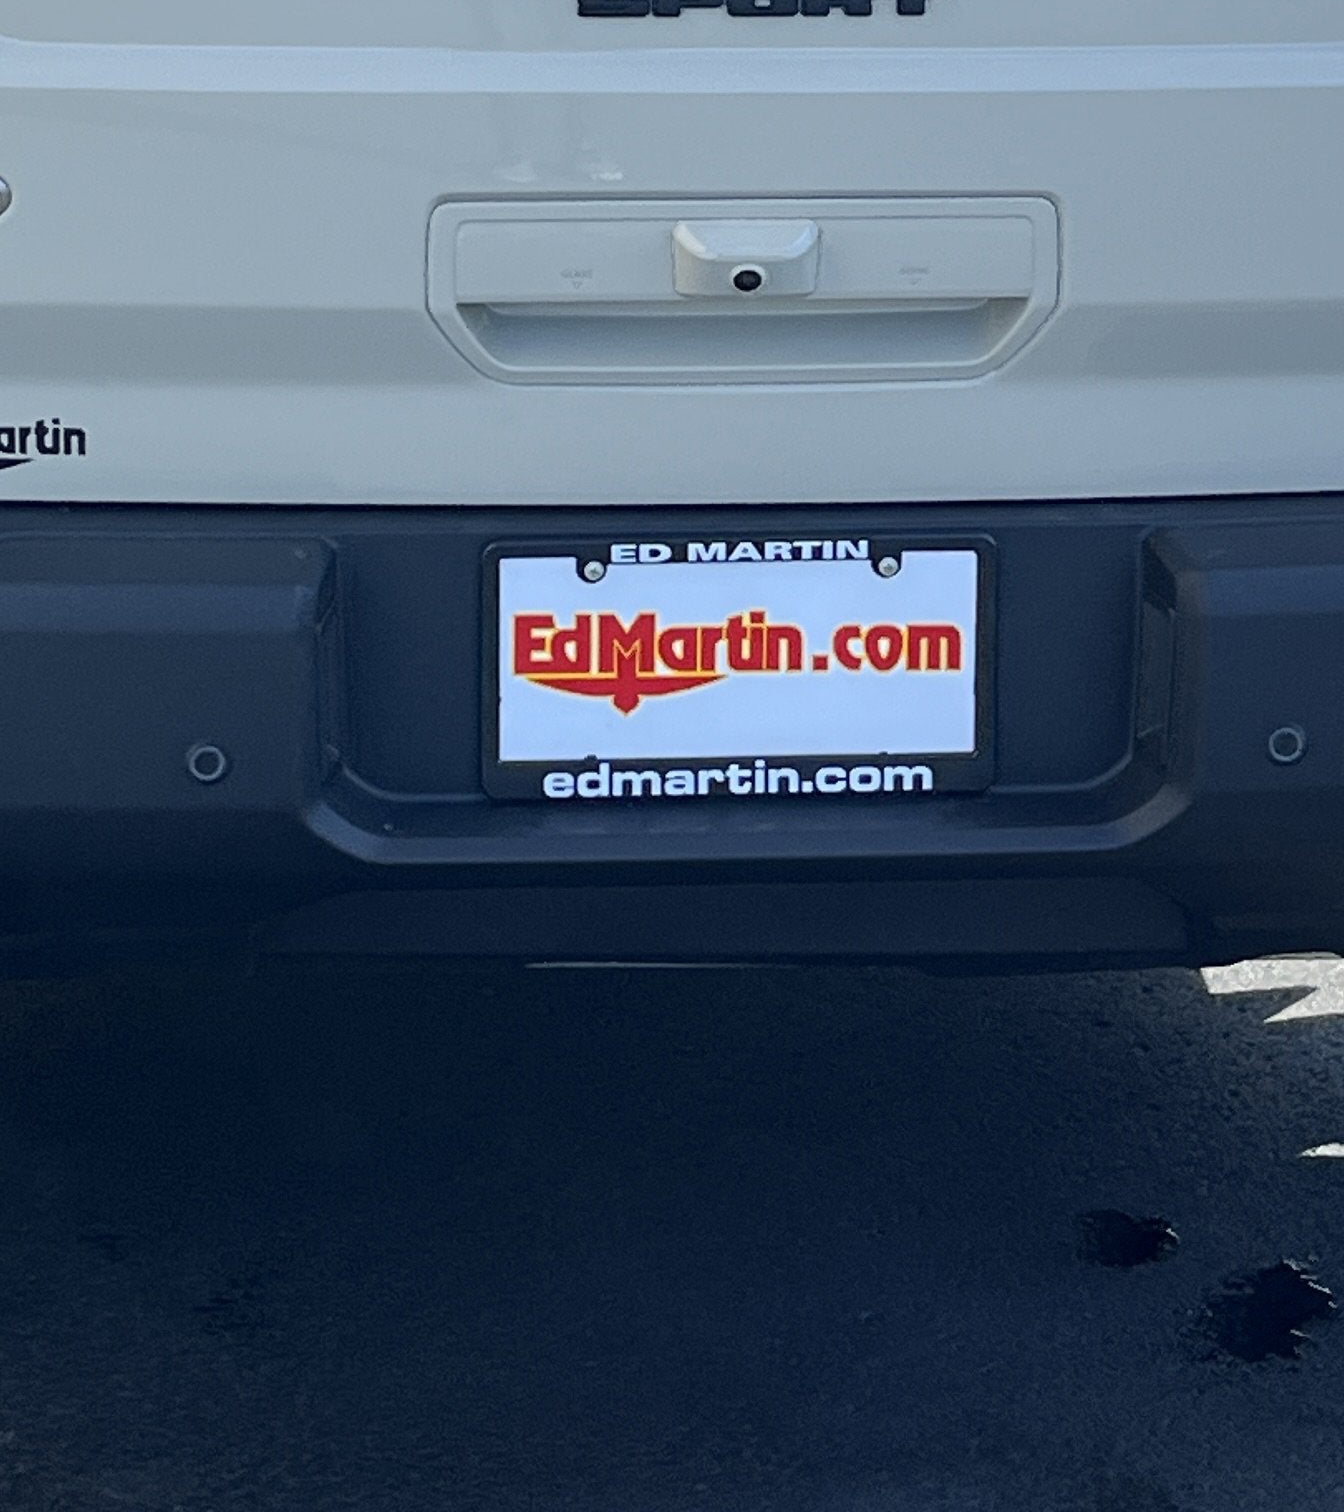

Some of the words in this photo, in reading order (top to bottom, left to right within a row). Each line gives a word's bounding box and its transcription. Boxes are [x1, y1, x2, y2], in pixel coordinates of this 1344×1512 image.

[610, 543, 673, 564] ED
[687, 539, 869, 563] MARTIN
[511, 609, 962, 677] EdMartin.com
[542, 758, 934, 799] edmartin.com
